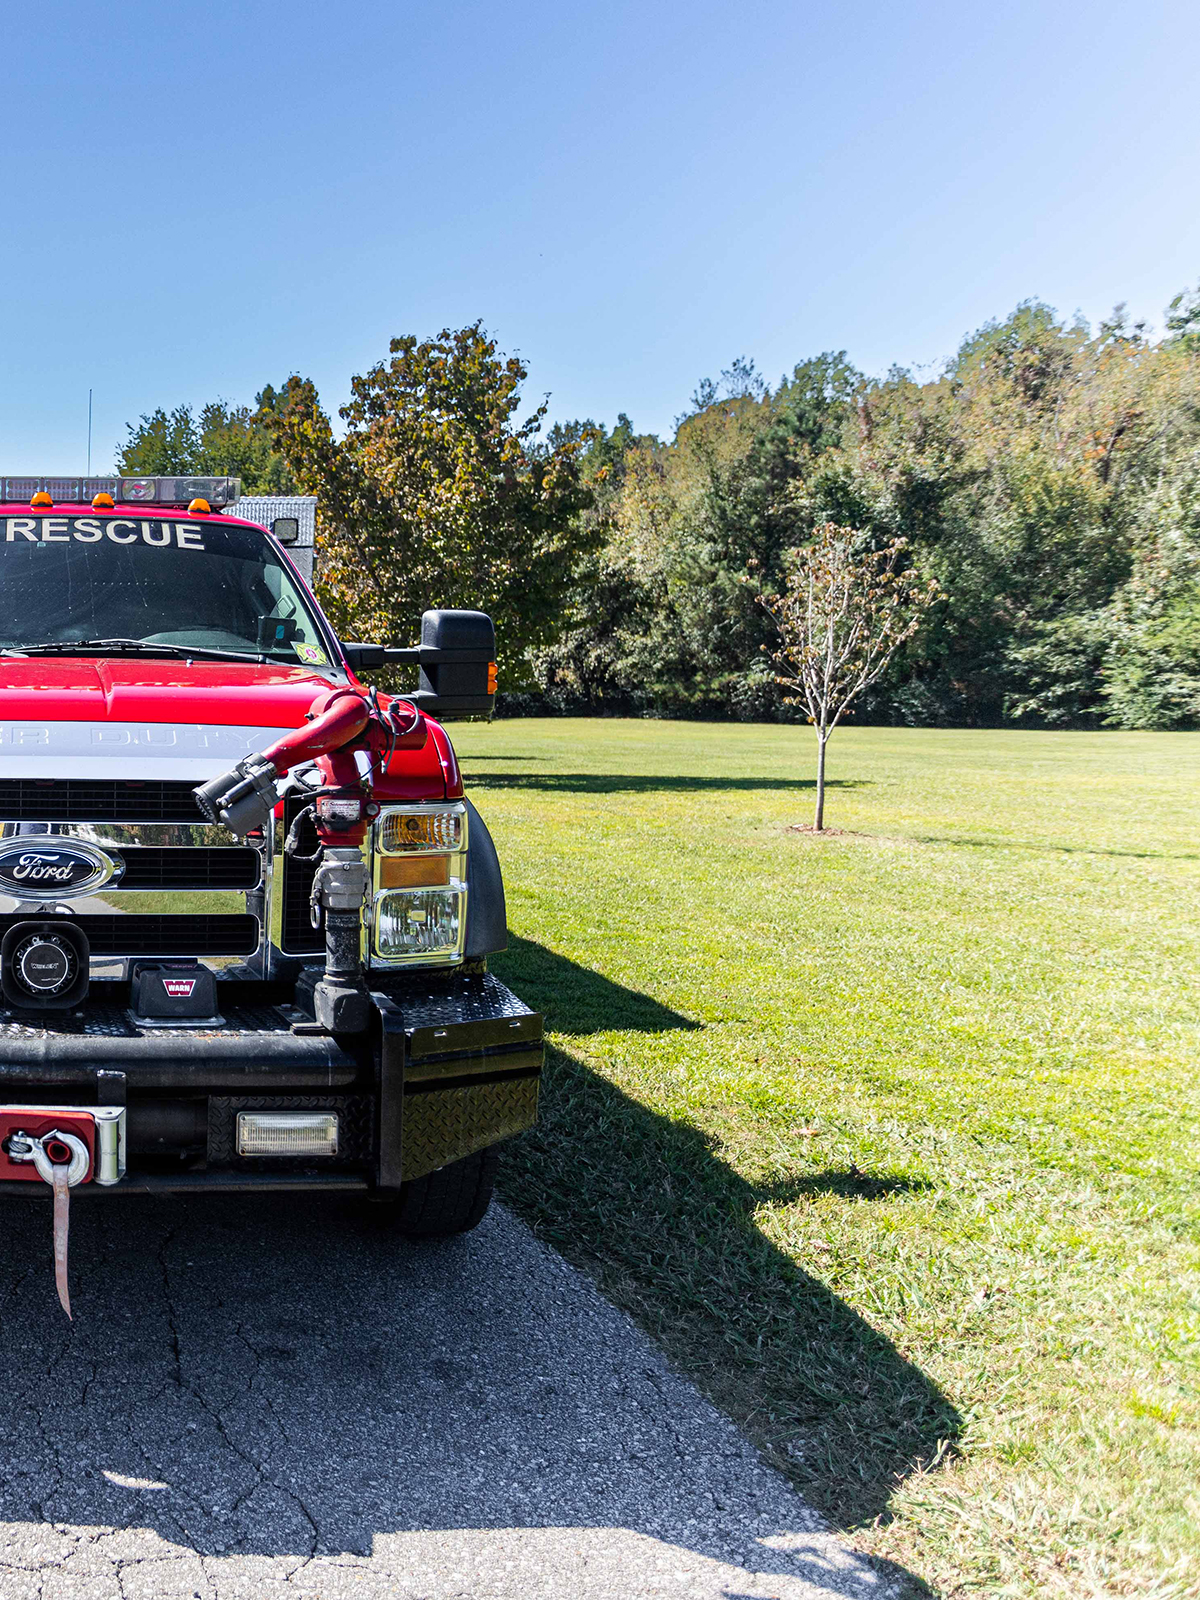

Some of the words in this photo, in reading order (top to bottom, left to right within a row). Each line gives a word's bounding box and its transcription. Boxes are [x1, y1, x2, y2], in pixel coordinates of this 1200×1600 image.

[5, 517, 205, 550] RESCUE
[90, 728, 261, 748] DUTY
[12, 853, 75, 880] Ford
[168, 984, 191, 992] WARN
